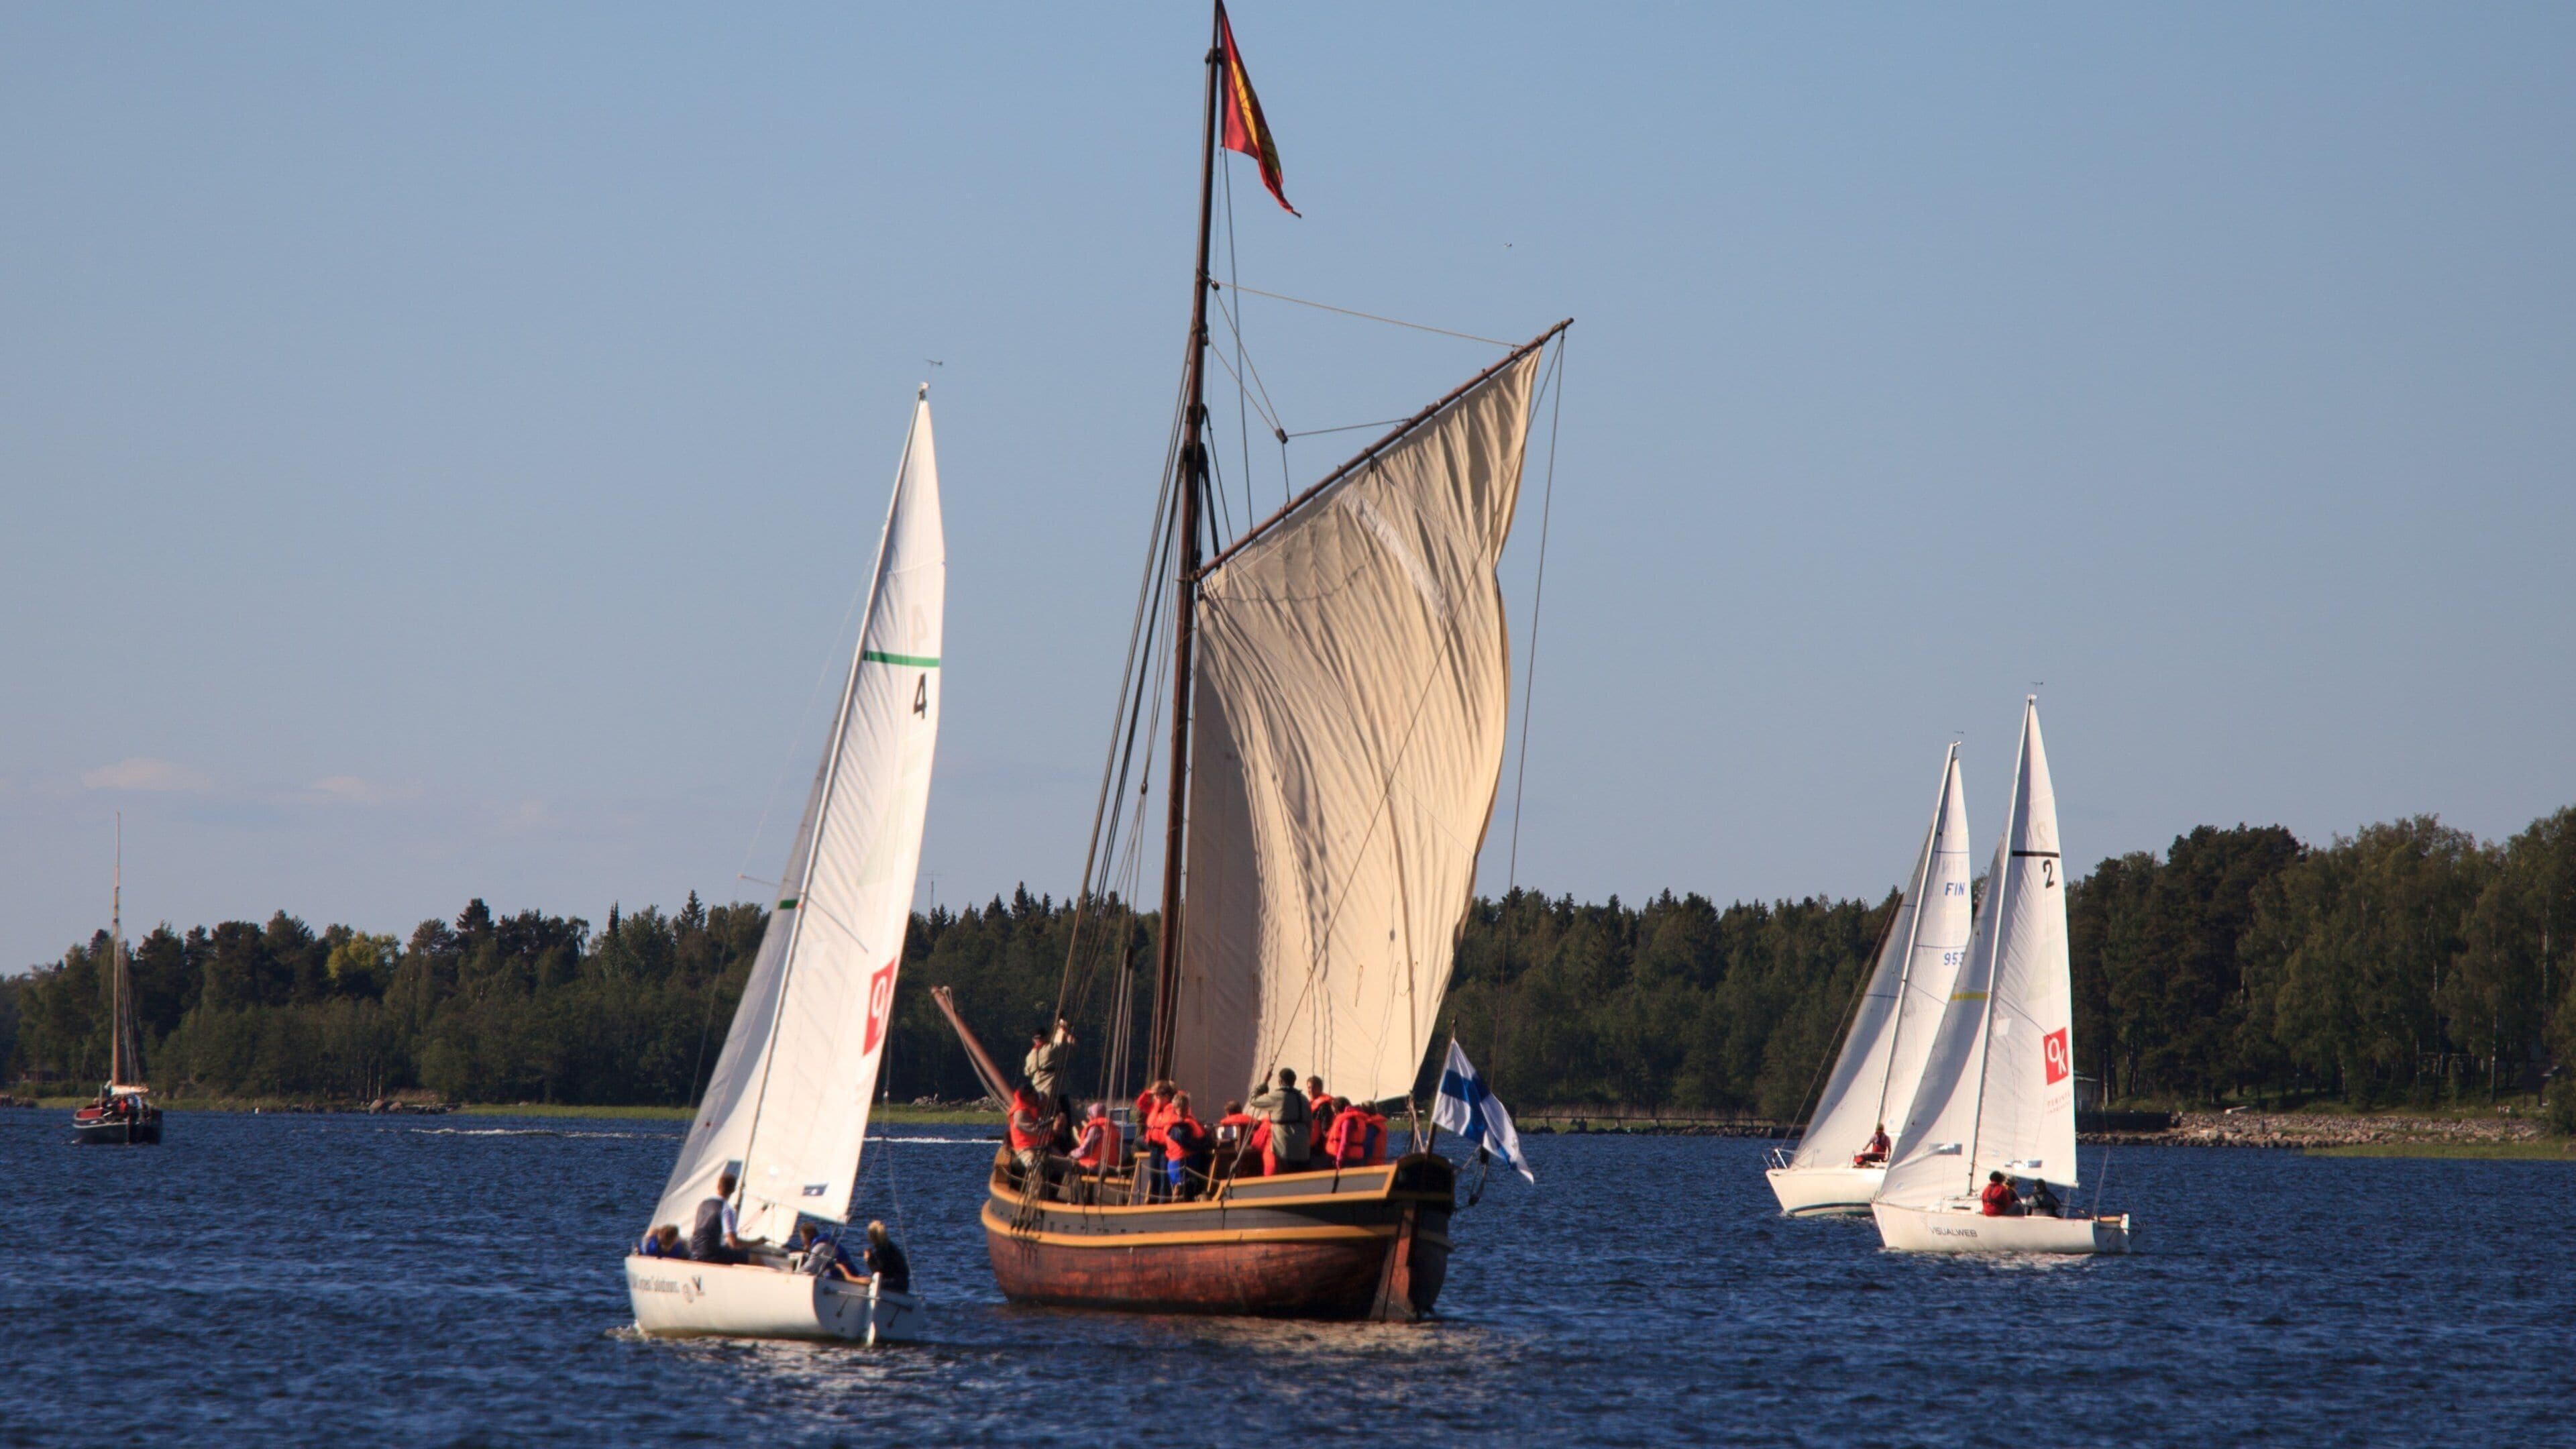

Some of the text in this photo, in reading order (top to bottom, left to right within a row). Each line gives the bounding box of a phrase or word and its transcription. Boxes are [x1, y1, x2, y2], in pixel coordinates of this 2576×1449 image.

[913, 672, 927, 720] 4
[1945, 882, 1965, 896] FIN
[2043, 859, 2055, 889] 2
[2047, 1036, 2067, 1075] OK
[1929, 1226, 1978, 1238] VISUALWEB
